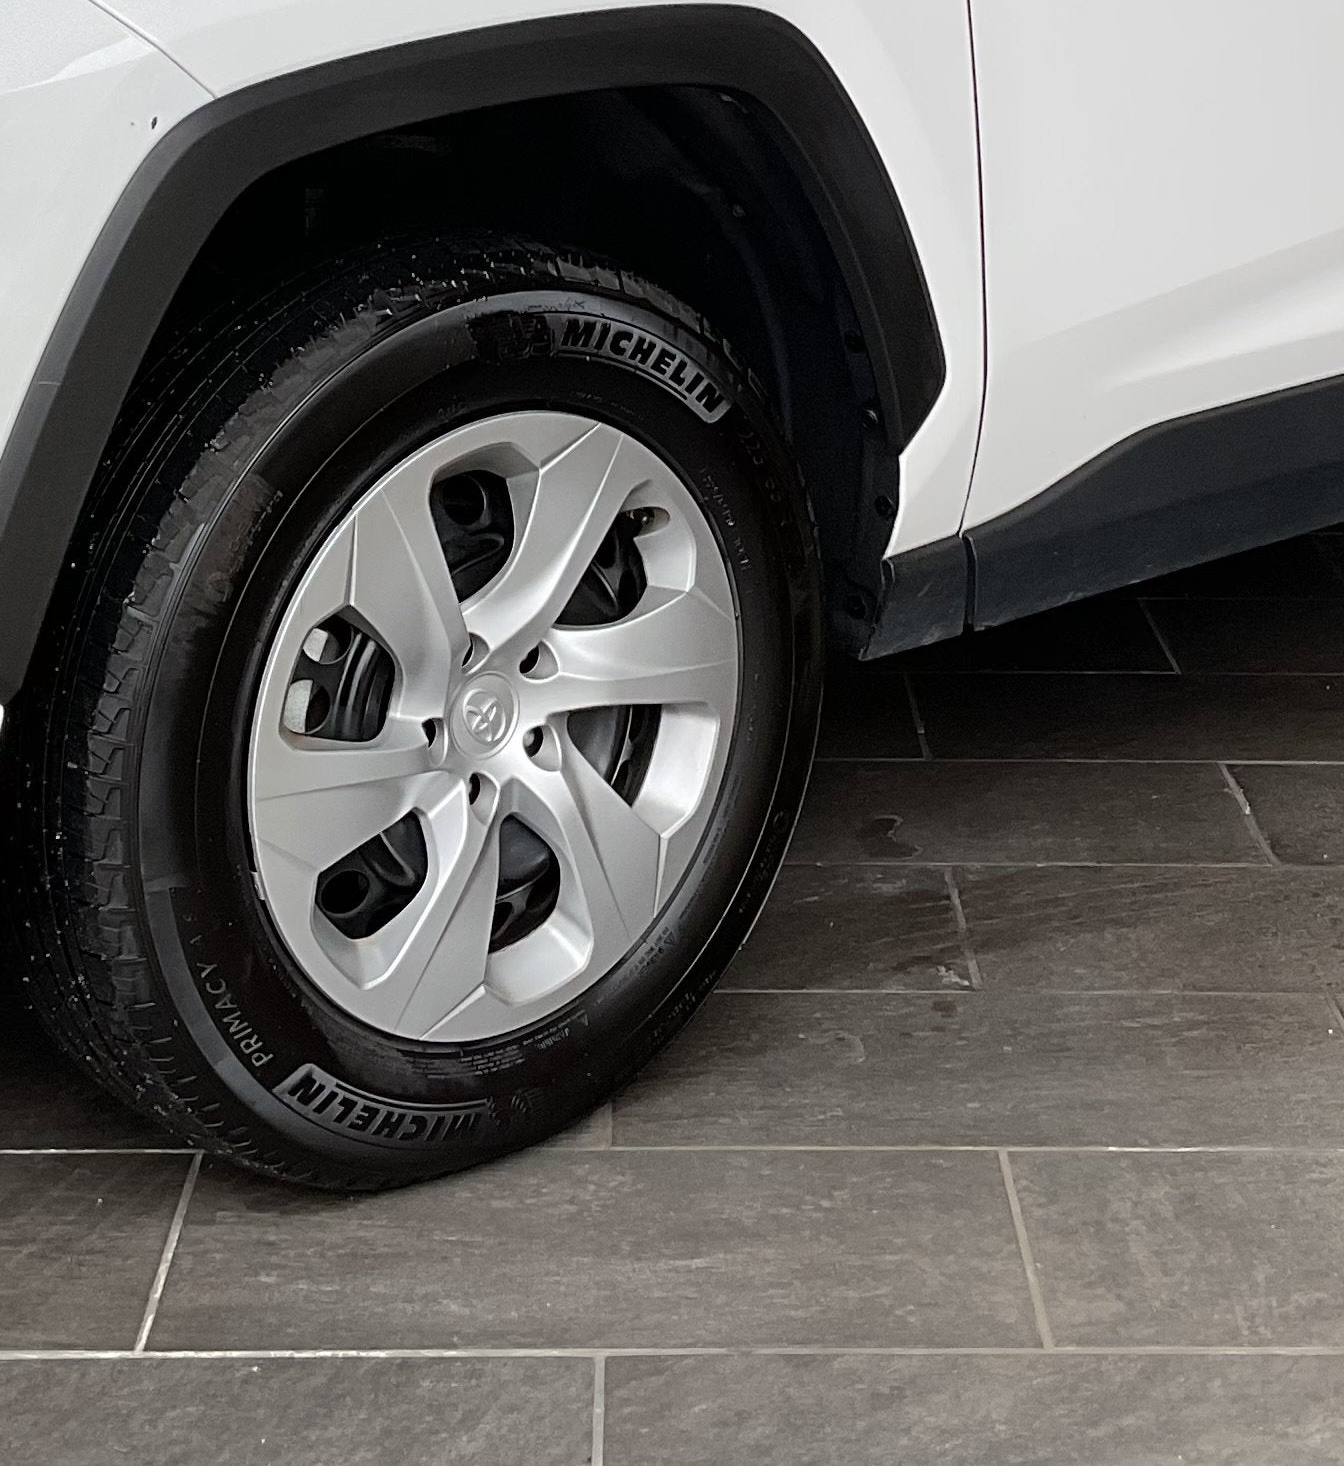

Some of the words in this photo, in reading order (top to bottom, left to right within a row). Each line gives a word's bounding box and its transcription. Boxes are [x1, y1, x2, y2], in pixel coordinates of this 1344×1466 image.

[561, 319, 725, 413] MICHELIN
[196, 961, 274, 1068] PRIMACY
[287, 1076, 481, 1143] MICHELIN
